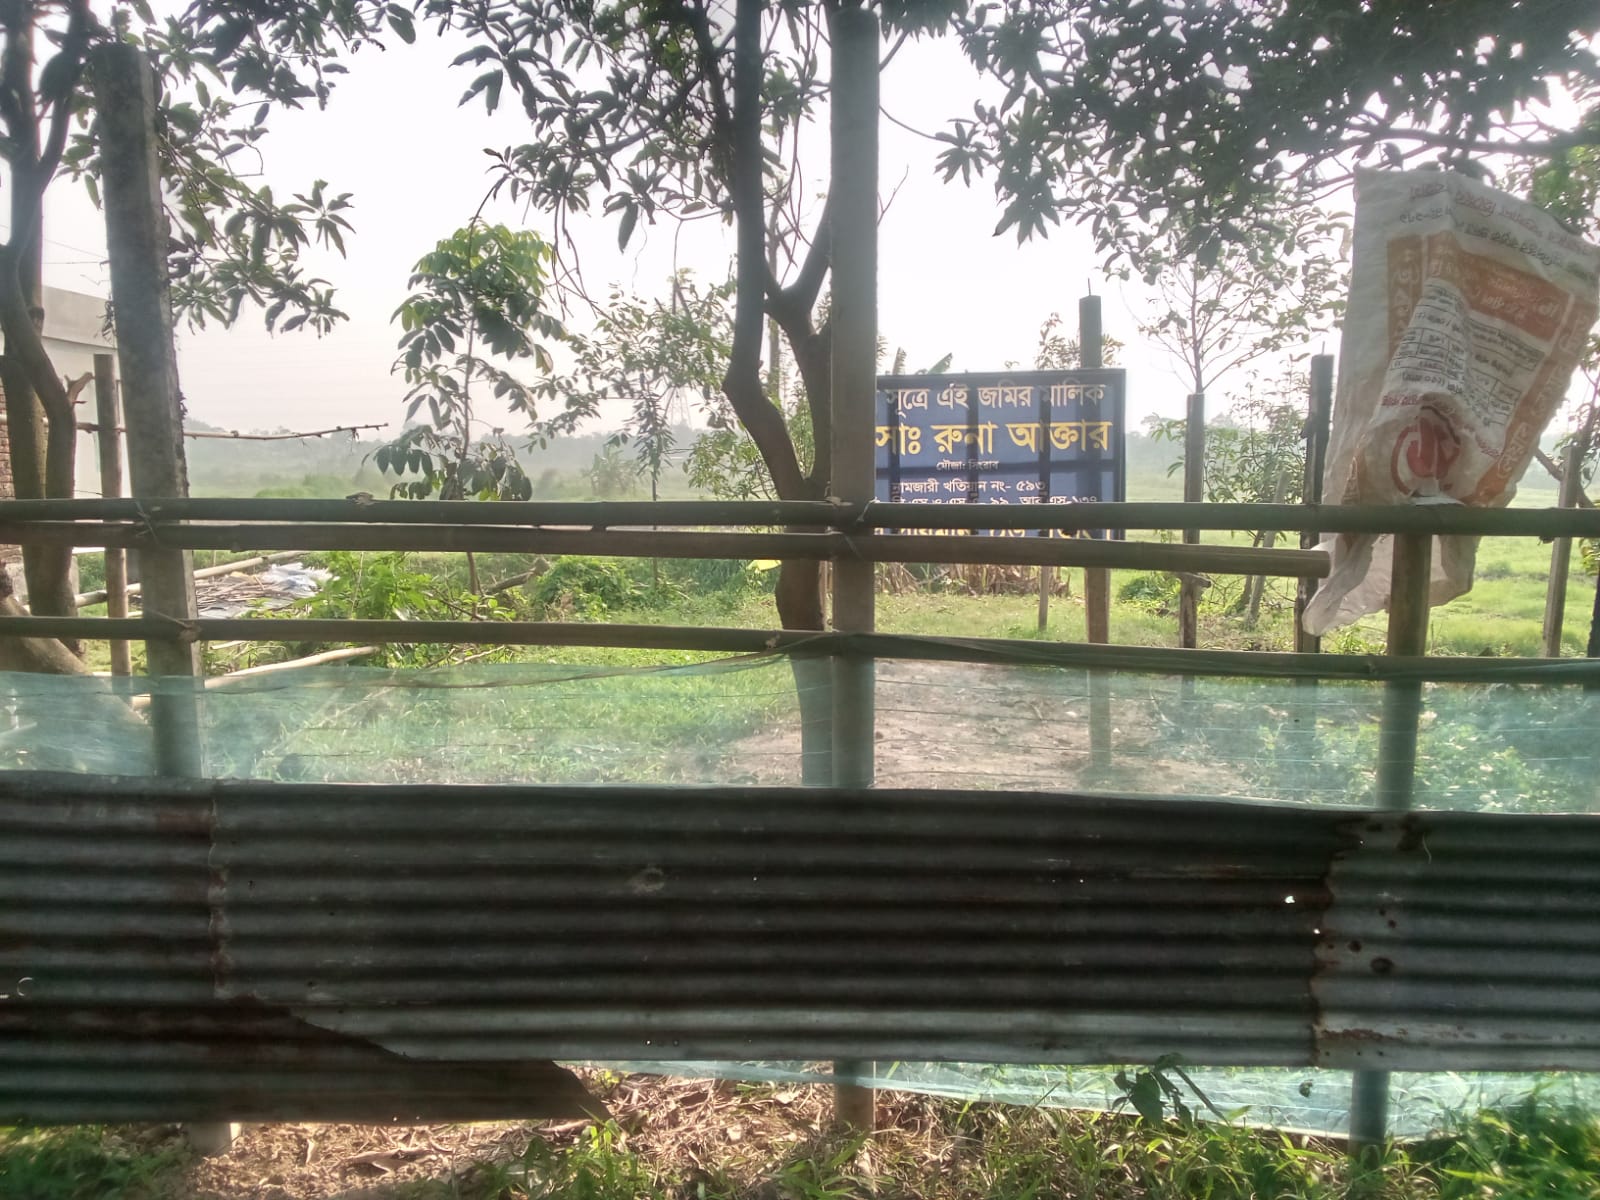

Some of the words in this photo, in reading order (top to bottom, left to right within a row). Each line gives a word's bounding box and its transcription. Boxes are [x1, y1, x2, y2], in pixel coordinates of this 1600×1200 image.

[937, 382, 969, 410] এই
[978, 380, 1034, 408] জমির
[1038, 377, 1106, 408] মালিক
[929, 420, 1000, 455] রুনা
[1005, 418, 1113, 454] আক্তার
